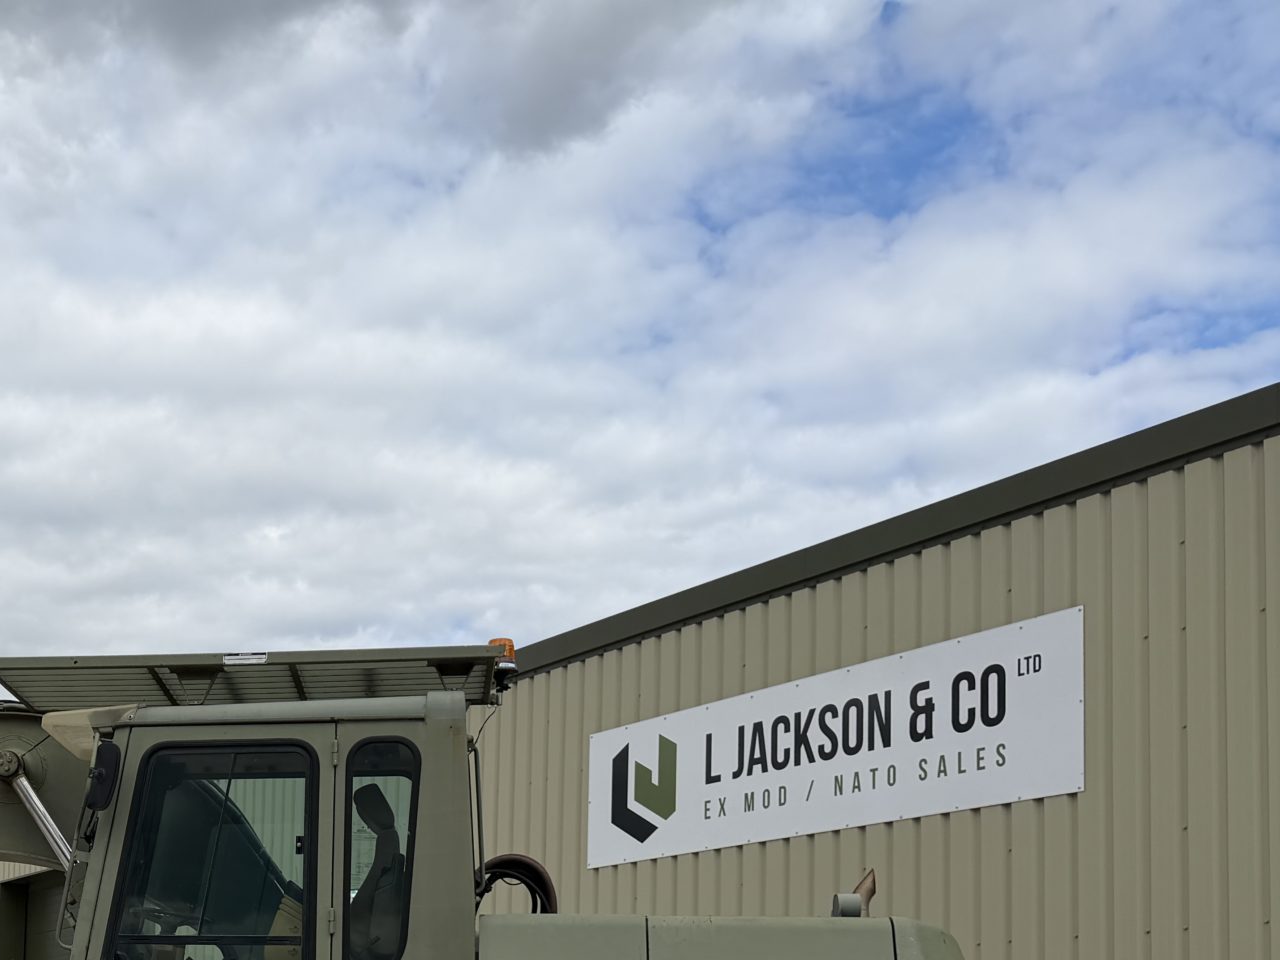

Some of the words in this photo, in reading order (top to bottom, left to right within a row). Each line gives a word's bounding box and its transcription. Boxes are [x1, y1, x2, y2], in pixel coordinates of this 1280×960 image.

[704, 733, 722, 785] L
[731, 689, 892, 780] JACKSON
[909, 680, 935, 743] &
[951, 663, 1007, 734] CO
[1017, 653, 1042, 677] LTD
[704, 797, 727, 820] EX
[744, 785, 787, 813] MOD
[833, 764, 897, 797] NATO
[918, 743, 1007, 781] SALES
